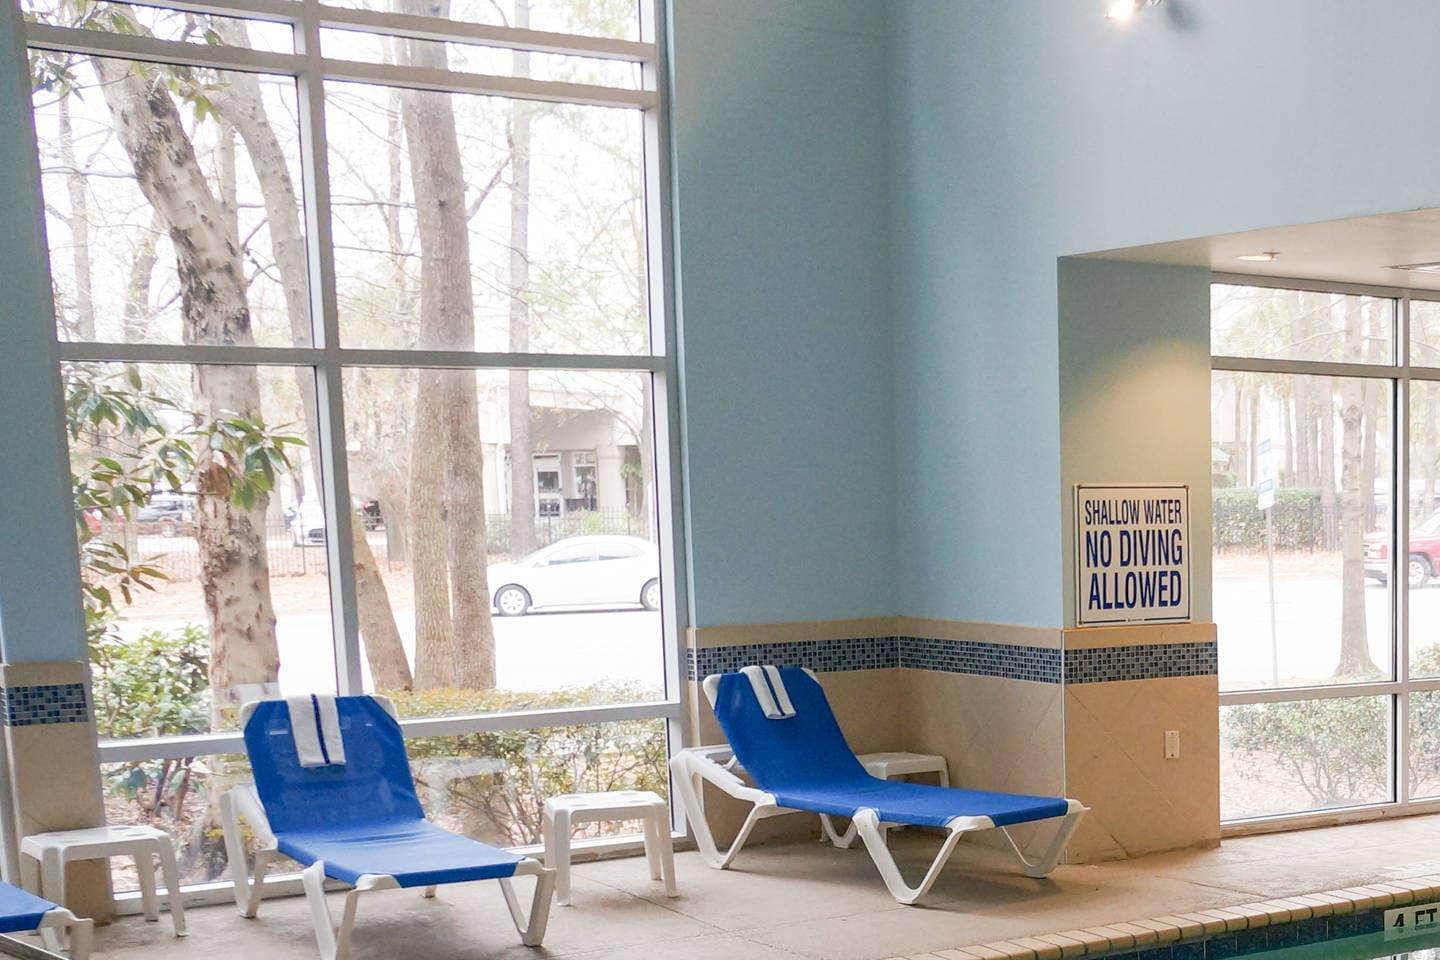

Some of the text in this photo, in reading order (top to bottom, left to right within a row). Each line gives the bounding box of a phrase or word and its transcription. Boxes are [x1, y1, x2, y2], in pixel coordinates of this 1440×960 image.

[1085, 500, 1182, 525] SHALLOW WATER
[1086, 529, 1182, 568] NO DIVING
[1088, 570, 1182, 610] ALLOWED
